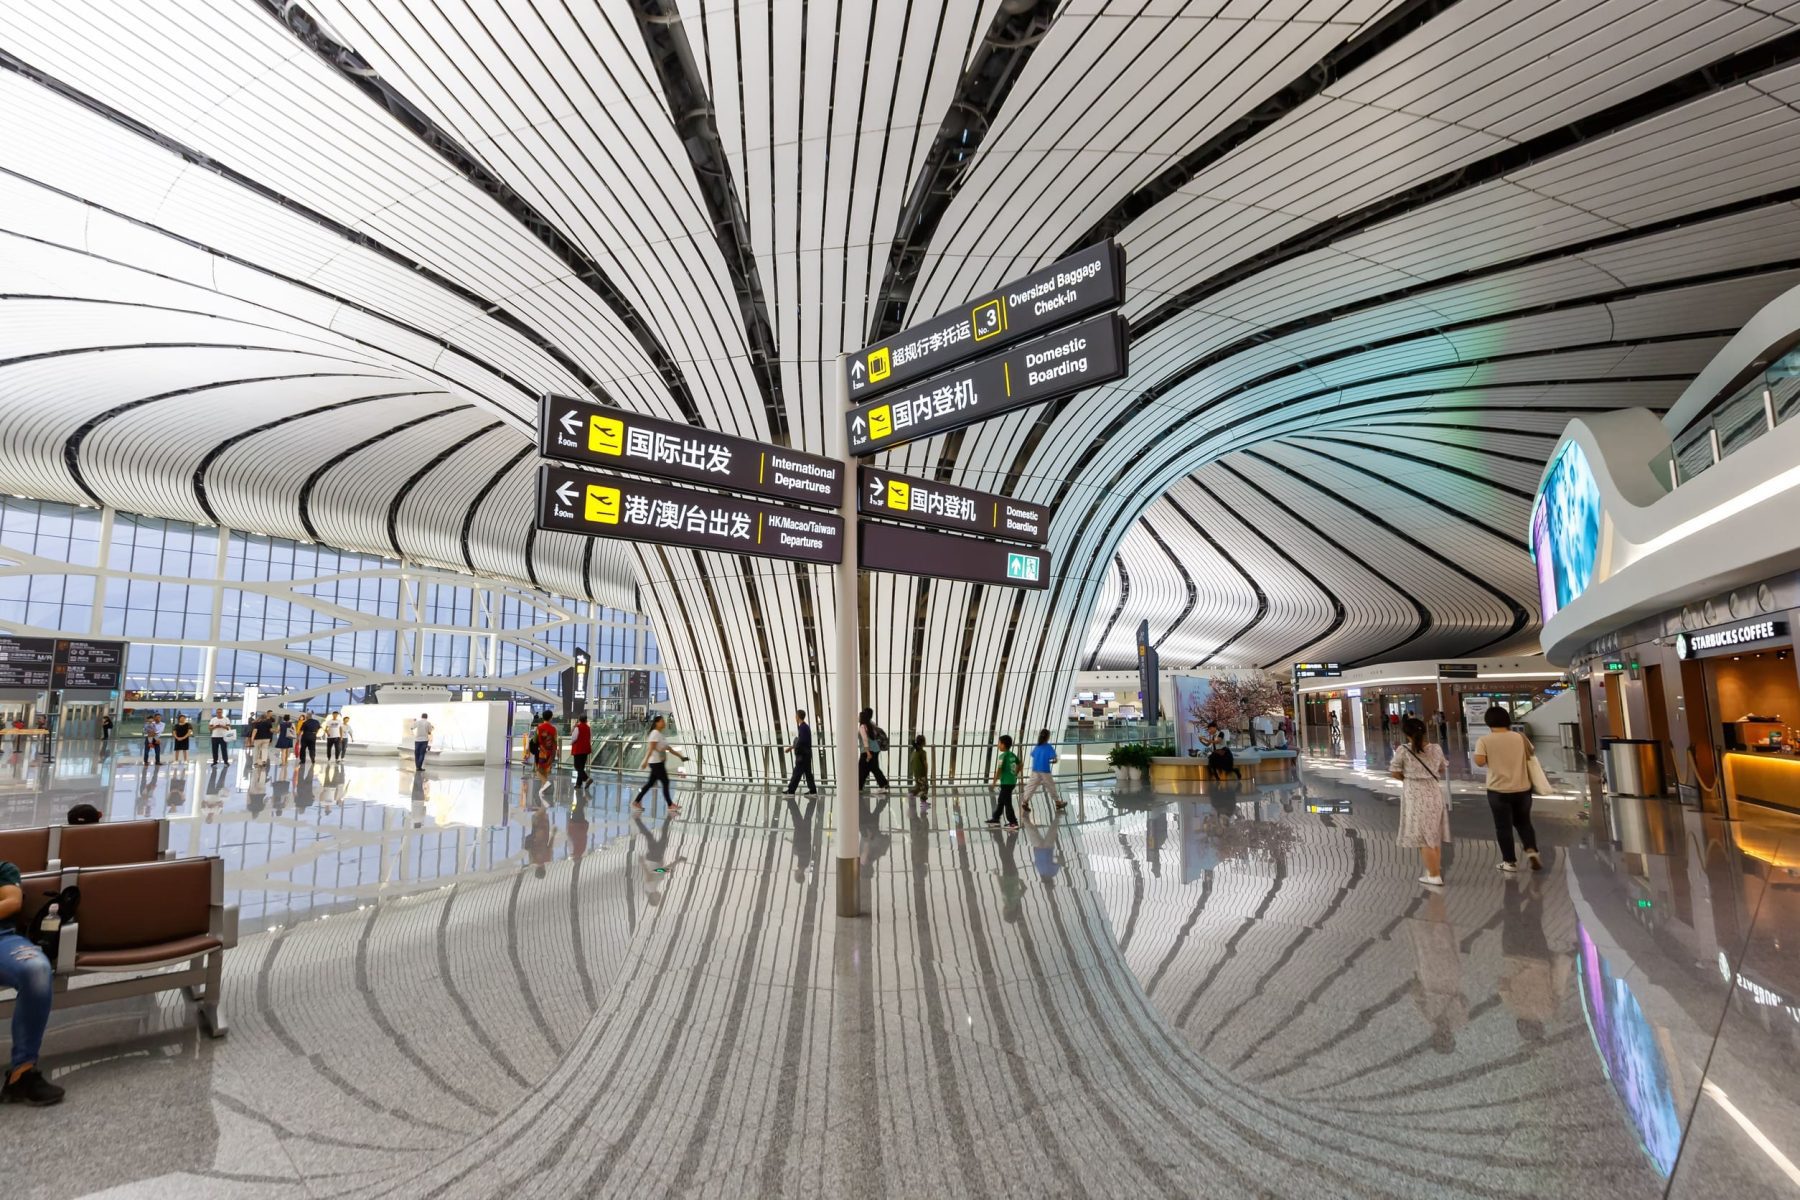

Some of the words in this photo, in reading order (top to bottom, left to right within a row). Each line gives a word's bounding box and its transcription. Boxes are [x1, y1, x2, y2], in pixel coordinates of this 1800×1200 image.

[1009, 279, 1055, 308] Oversized
[1057, 259, 1102, 289] Baggage
[986, 308, 997, 327] 3
[1034, 289, 1077, 316] Check-in
[892, 320, 971, 368] 超规行李托运
[1026, 336, 1087, 368] Domestic
[1028, 356, 1088, 386] Boarding
[892, 378, 978, 431] 国内登机
[626, 426, 732, 475] 国际出发
[772, 456, 835, 479] International
[775, 473, 831, 494] Departures
[624, 494, 752, 540] 港/澳/台出发
[911, 487, 976, 521] 国内登机
[1006, 506, 1039, 520] Domestic
[768, 515, 836, 535] HK/Macao/Taiwan
[1007, 519, 1038, 535] Boarding
[780, 533, 823, 549] Departures
[1691, 629, 1738, 651] STARBUCKS
[1738, 621, 1775, 642] COFFEE
